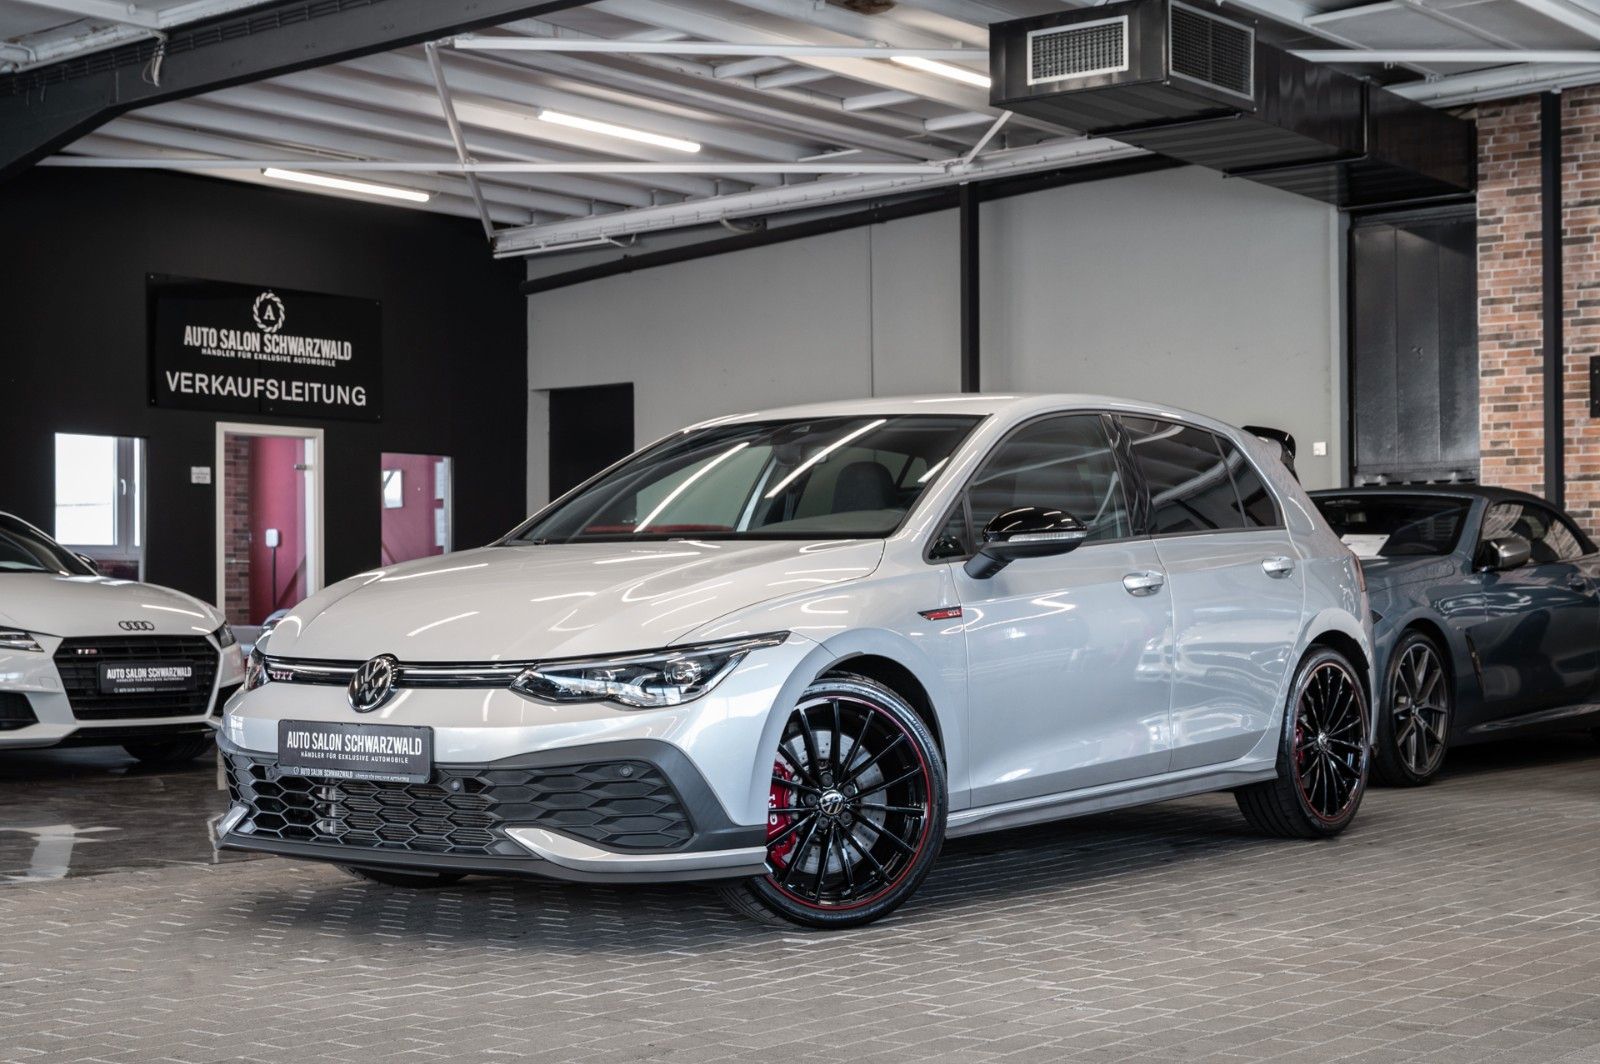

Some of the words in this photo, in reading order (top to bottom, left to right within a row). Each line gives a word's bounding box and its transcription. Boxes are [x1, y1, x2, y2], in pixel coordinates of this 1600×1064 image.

[263, 304, 276, 321] A
[184, 325, 217, 348] AUTO
[219, 328, 260, 352] SALON
[263, 333, 352, 361] SCHWARZWALD
[293, 356, 336, 367] AUTOMOBILE
[166, 370, 367, 407] VERKAUFSLEITUNG
[106, 668, 125, 680] AUTO
[125, 667, 147, 679] SALON
[147, 665, 192, 678] SCHWARZWALD
[271, 670, 294, 681] GTI
[287, 731, 310, 749] AUTO
[312, 733, 342, 752] SALON
[344, 734, 422, 756] SCHWARZWALD
[338, 753, 369, 762] EXKLUSIVE
[371, 755, 409, 764] AUTOMOBILE
